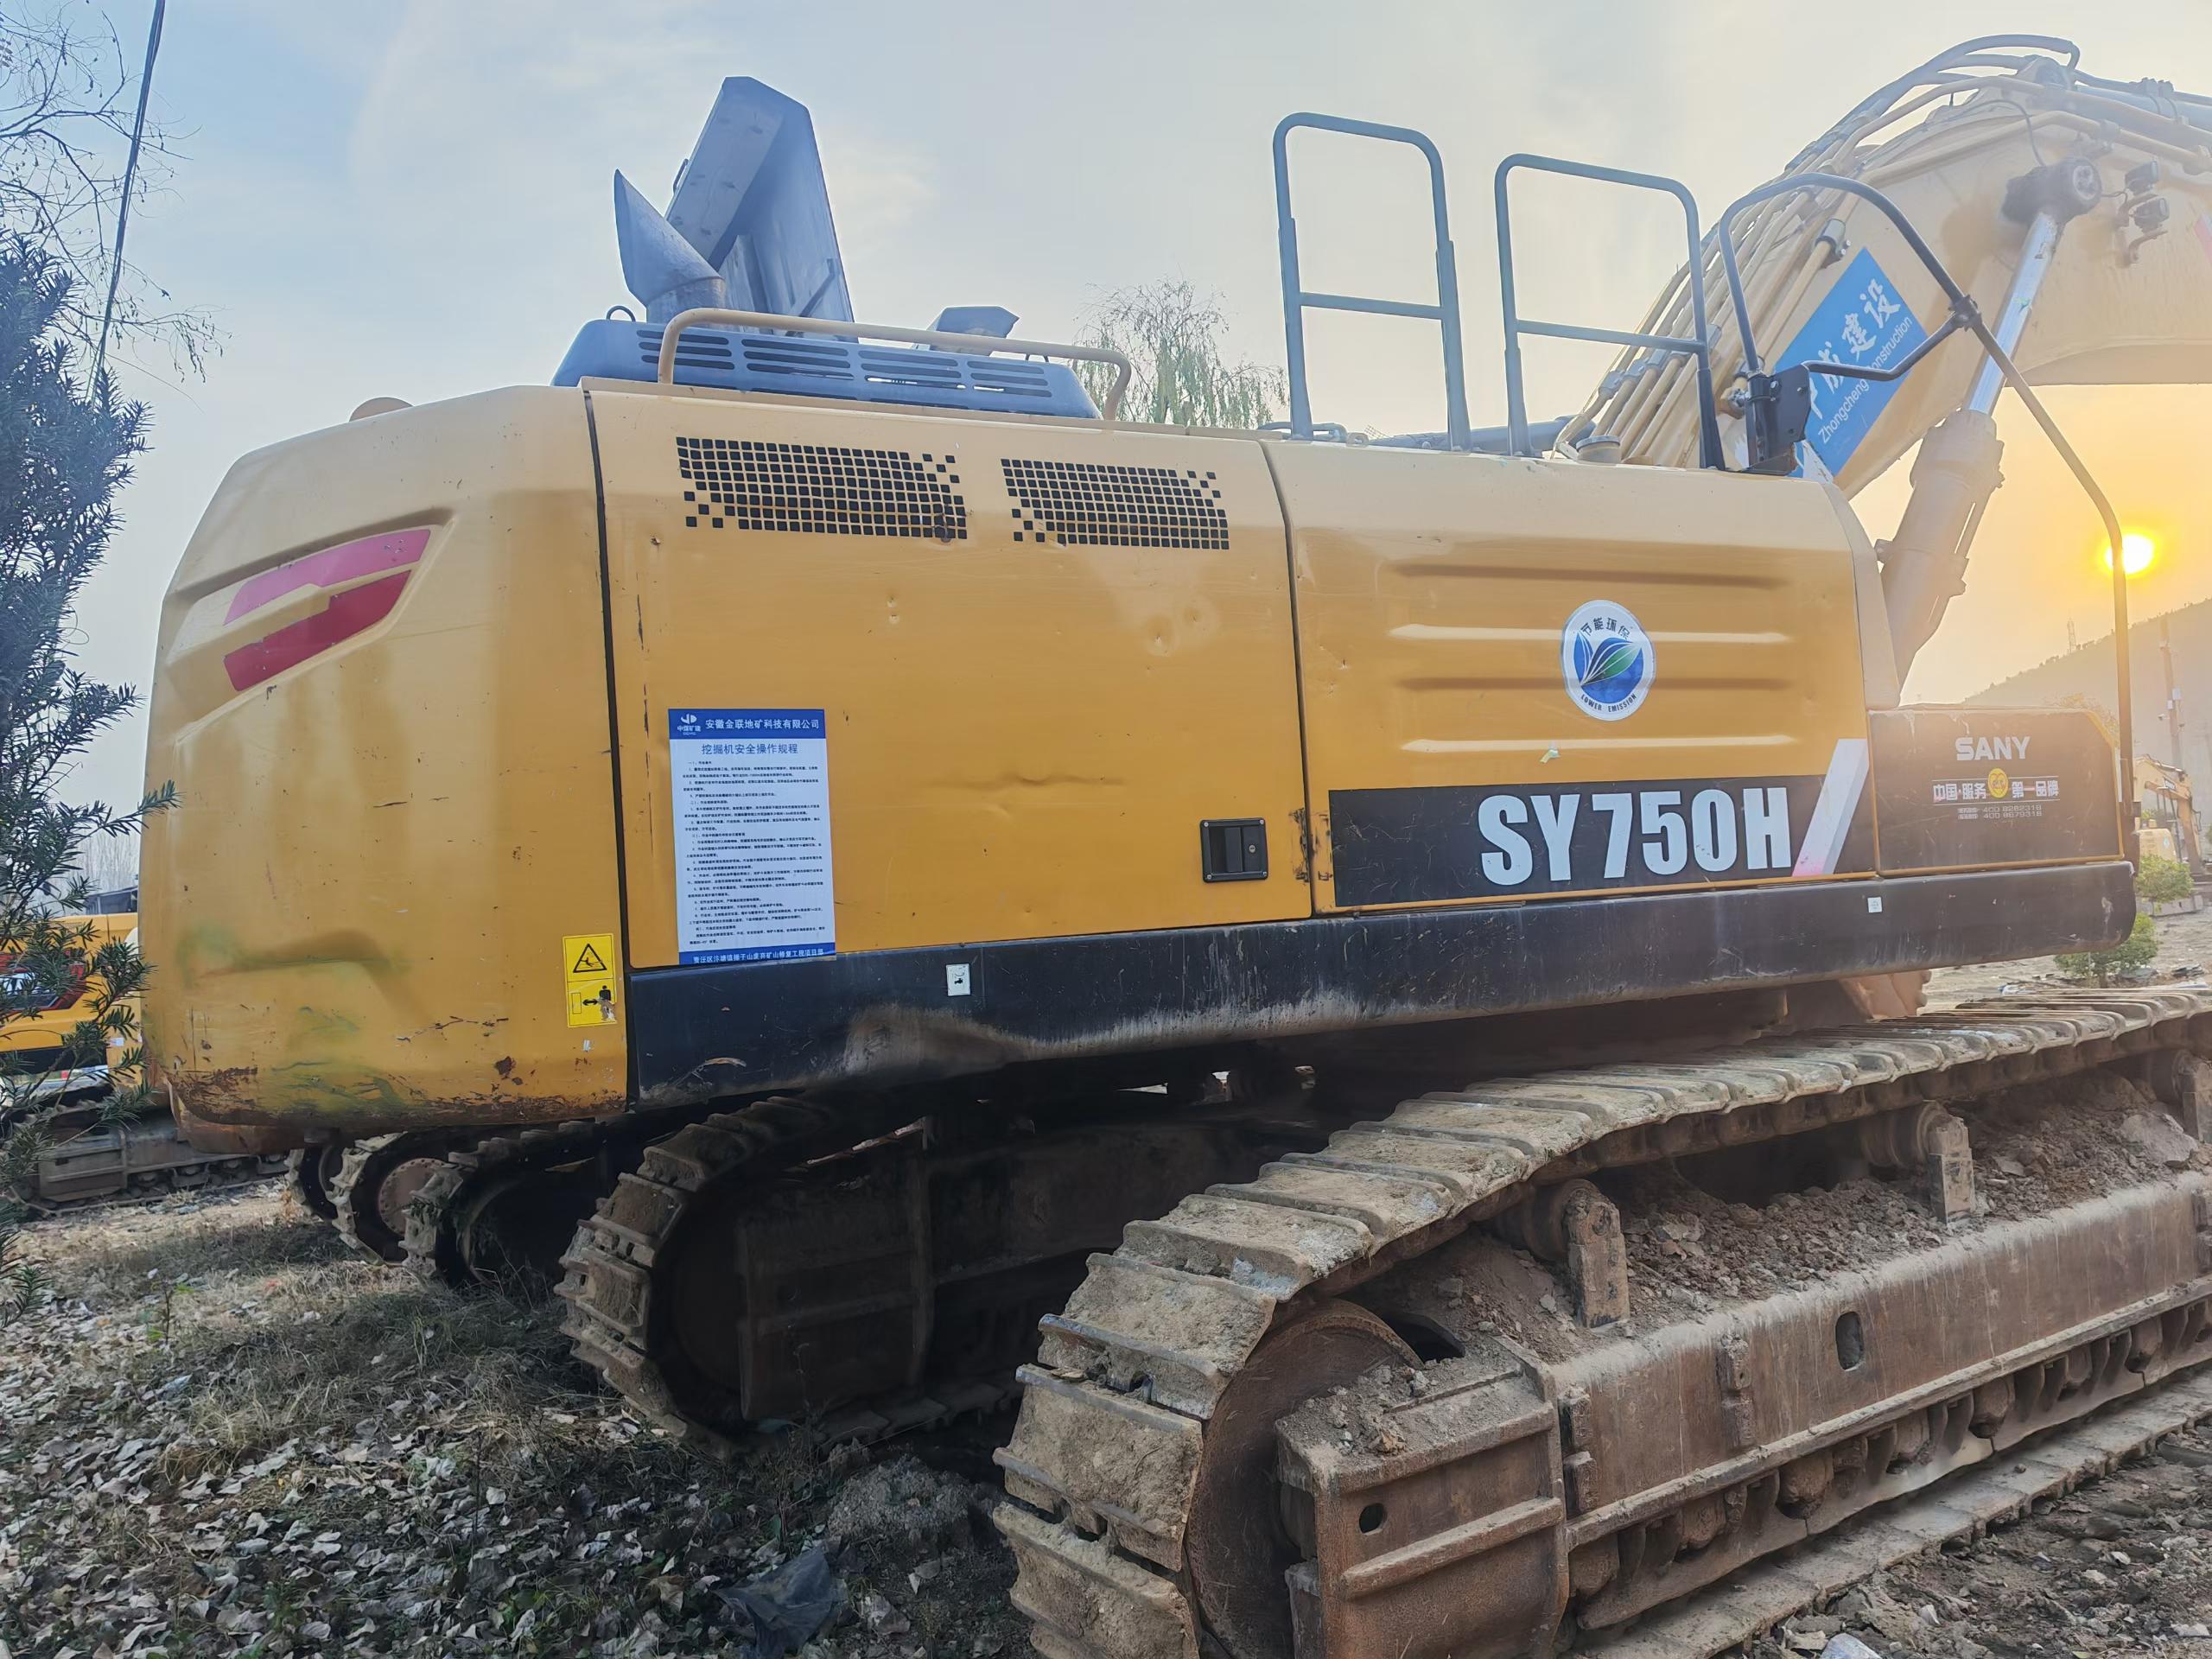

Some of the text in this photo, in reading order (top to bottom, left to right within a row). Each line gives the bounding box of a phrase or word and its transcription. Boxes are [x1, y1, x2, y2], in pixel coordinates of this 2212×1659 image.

[1818, 316, 1913, 444] Zhongcheng onstruction
[1580, 617, 1630, 640] 节能环保
[1580, 693, 1637, 713] LOWER EMISSION
[705, 719, 819, 729] 安徽金联地矿科技有限公司
[701, 743, 798, 755] 挖掘机安全操作规程
[1955, 735, 2031, 761] SANY
[1478, 786, 1791, 886] SY750H
